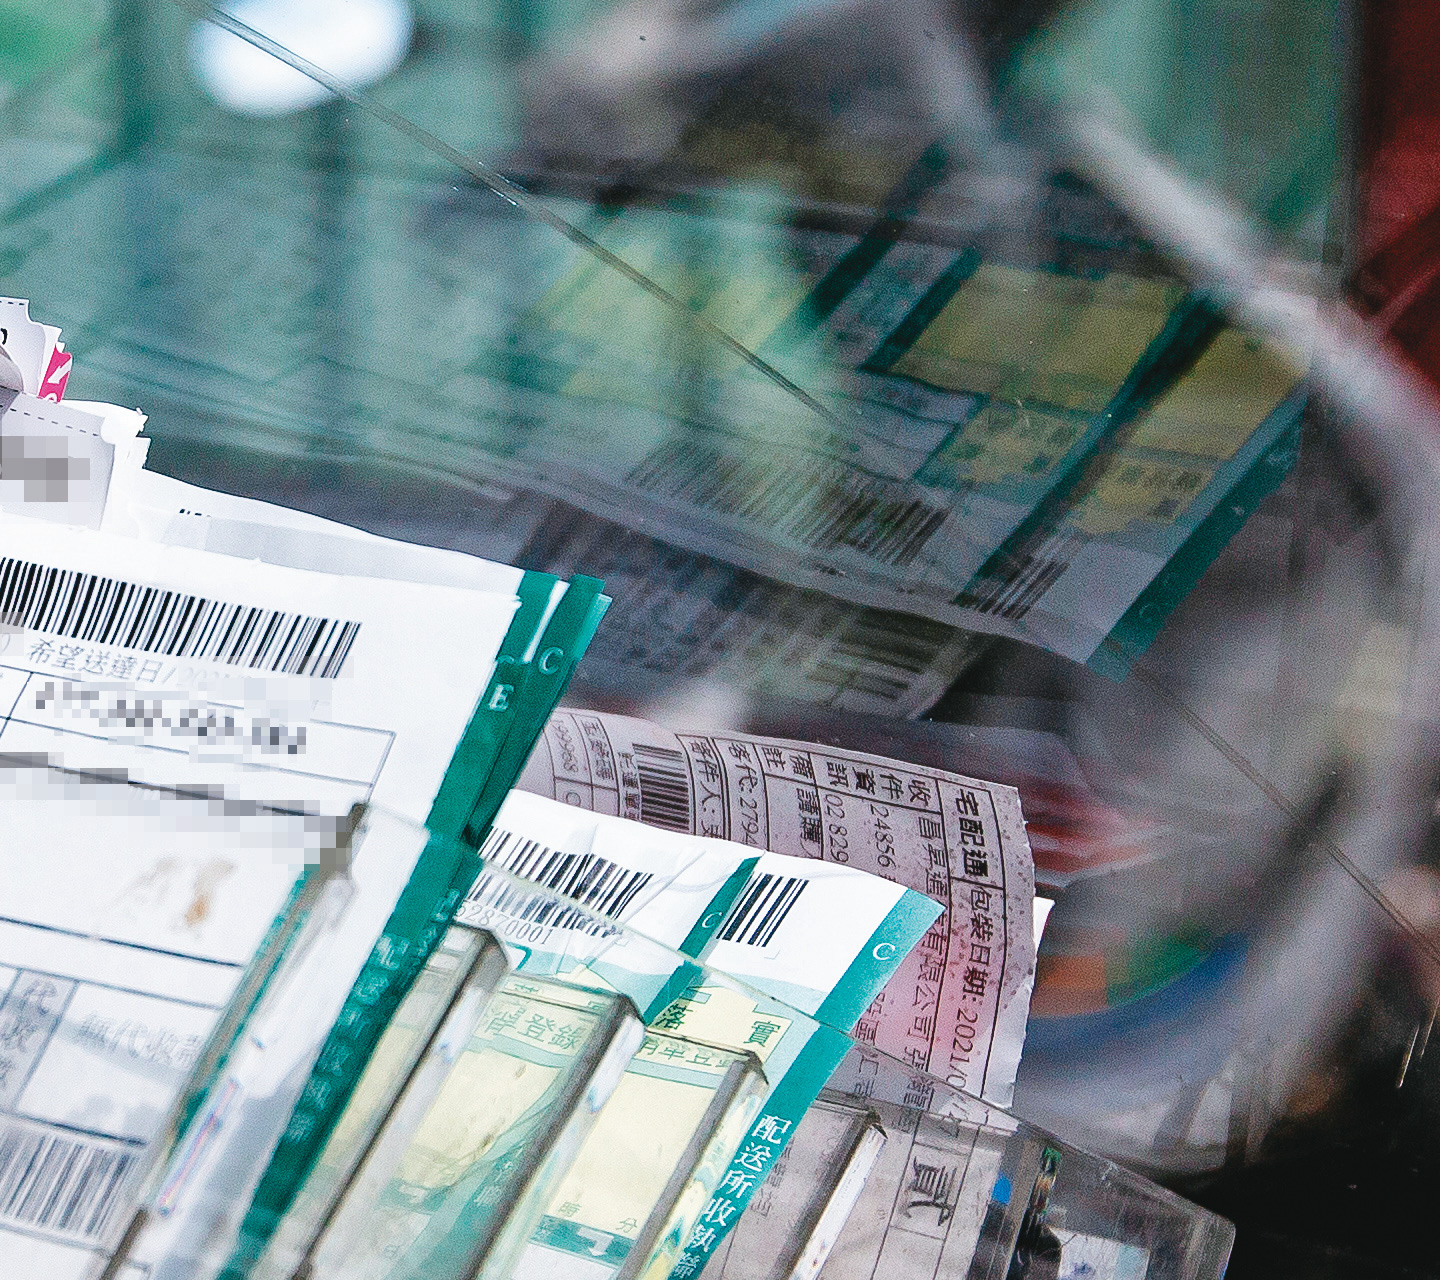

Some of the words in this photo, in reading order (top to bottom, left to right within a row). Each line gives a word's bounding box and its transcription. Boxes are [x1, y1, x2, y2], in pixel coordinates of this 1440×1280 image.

[826, 760, 932, 809] 收件資訊
[869, 803, 897, 870] 24856
[953, 787, 990, 879] 宅配通
[871, 941, 897, 961] C
